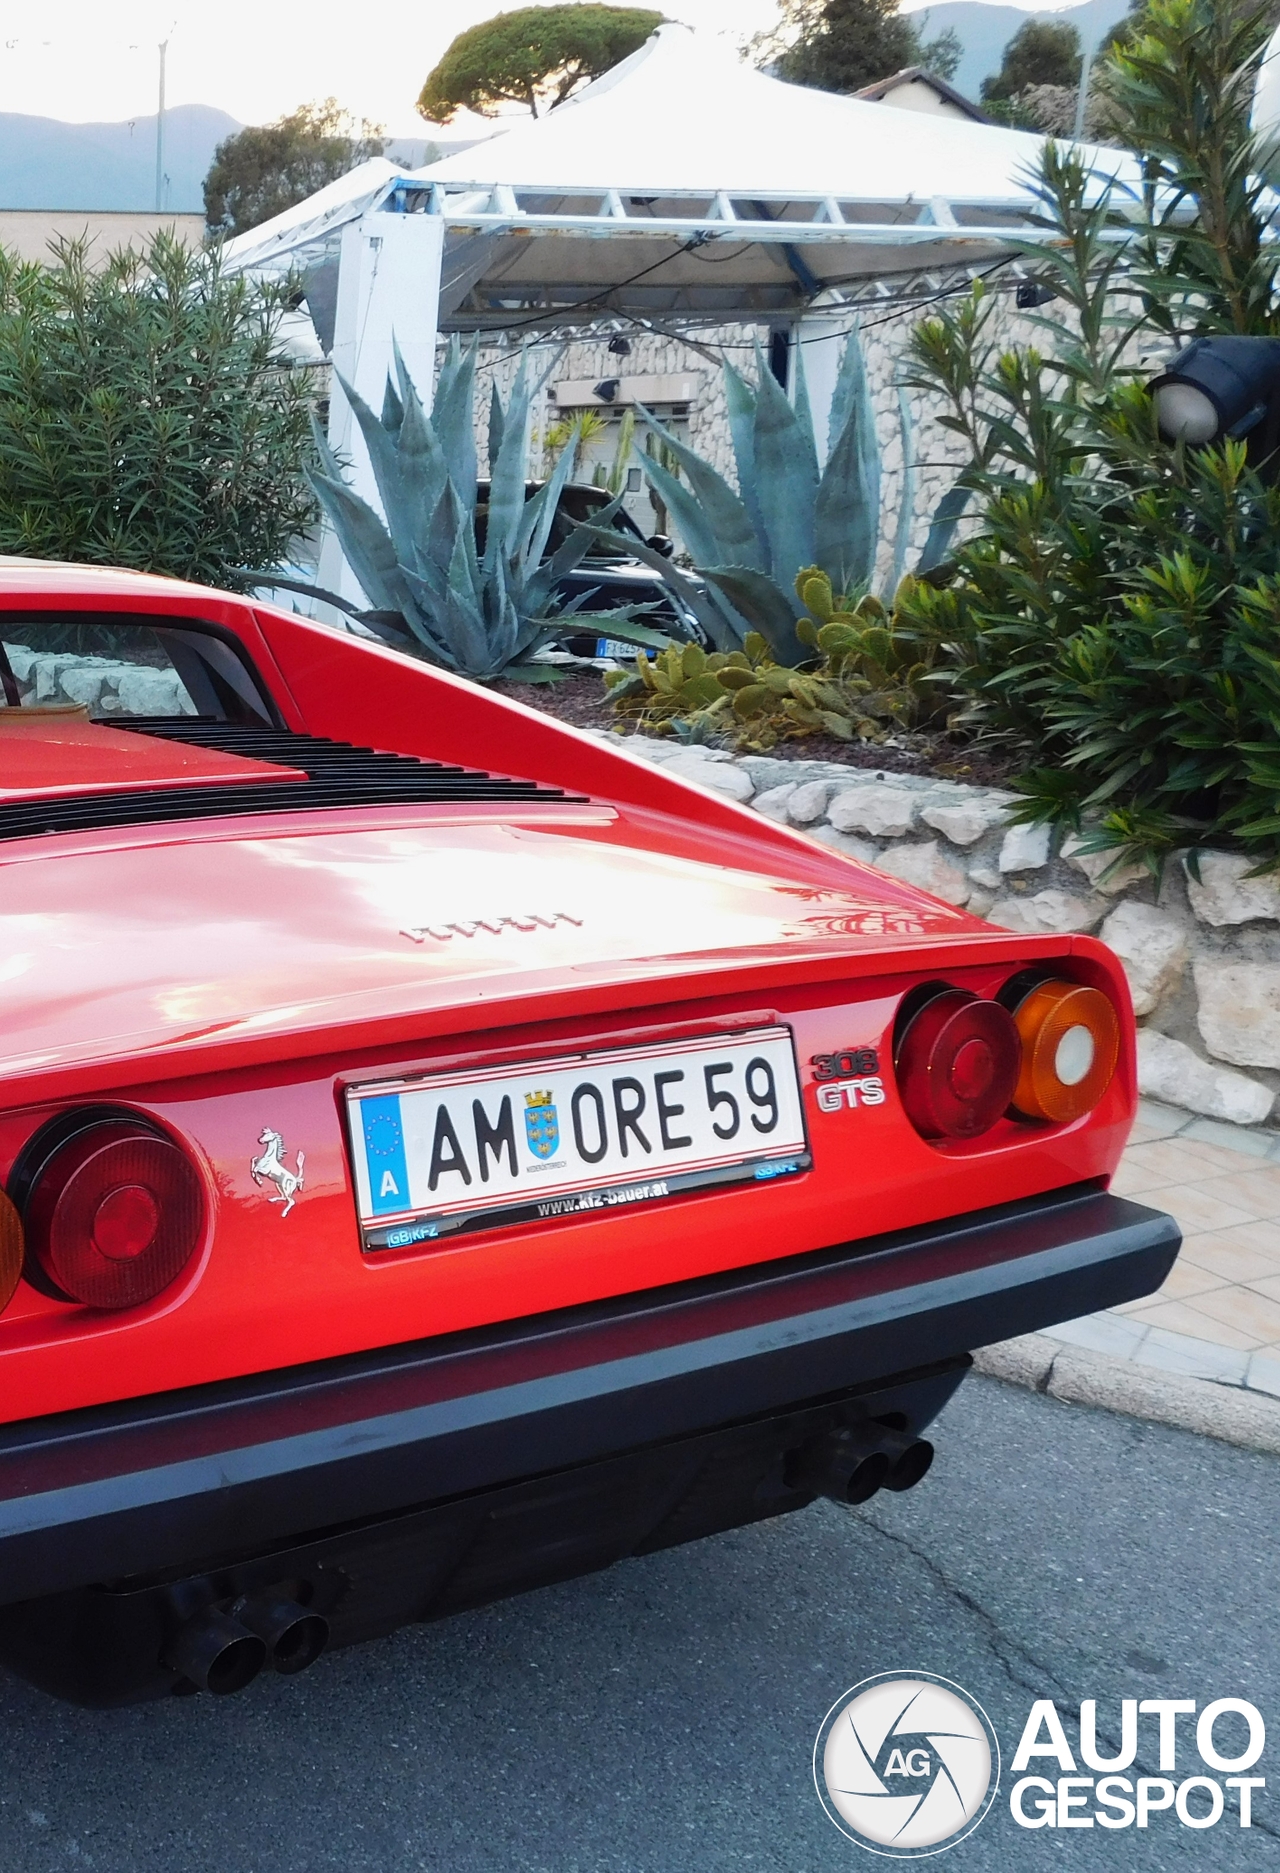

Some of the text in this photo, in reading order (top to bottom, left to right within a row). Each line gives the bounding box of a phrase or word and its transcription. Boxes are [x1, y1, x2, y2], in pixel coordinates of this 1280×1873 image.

[811, 1047, 879, 1082] 308
[816, 1076, 886, 1113] GTS
[380, 1056, 779, 1198] A AM ORE 59
[537, 1181, 670, 1217] www.kfz-bauer.at
[412, 1225, 439, 1241] KFZ
